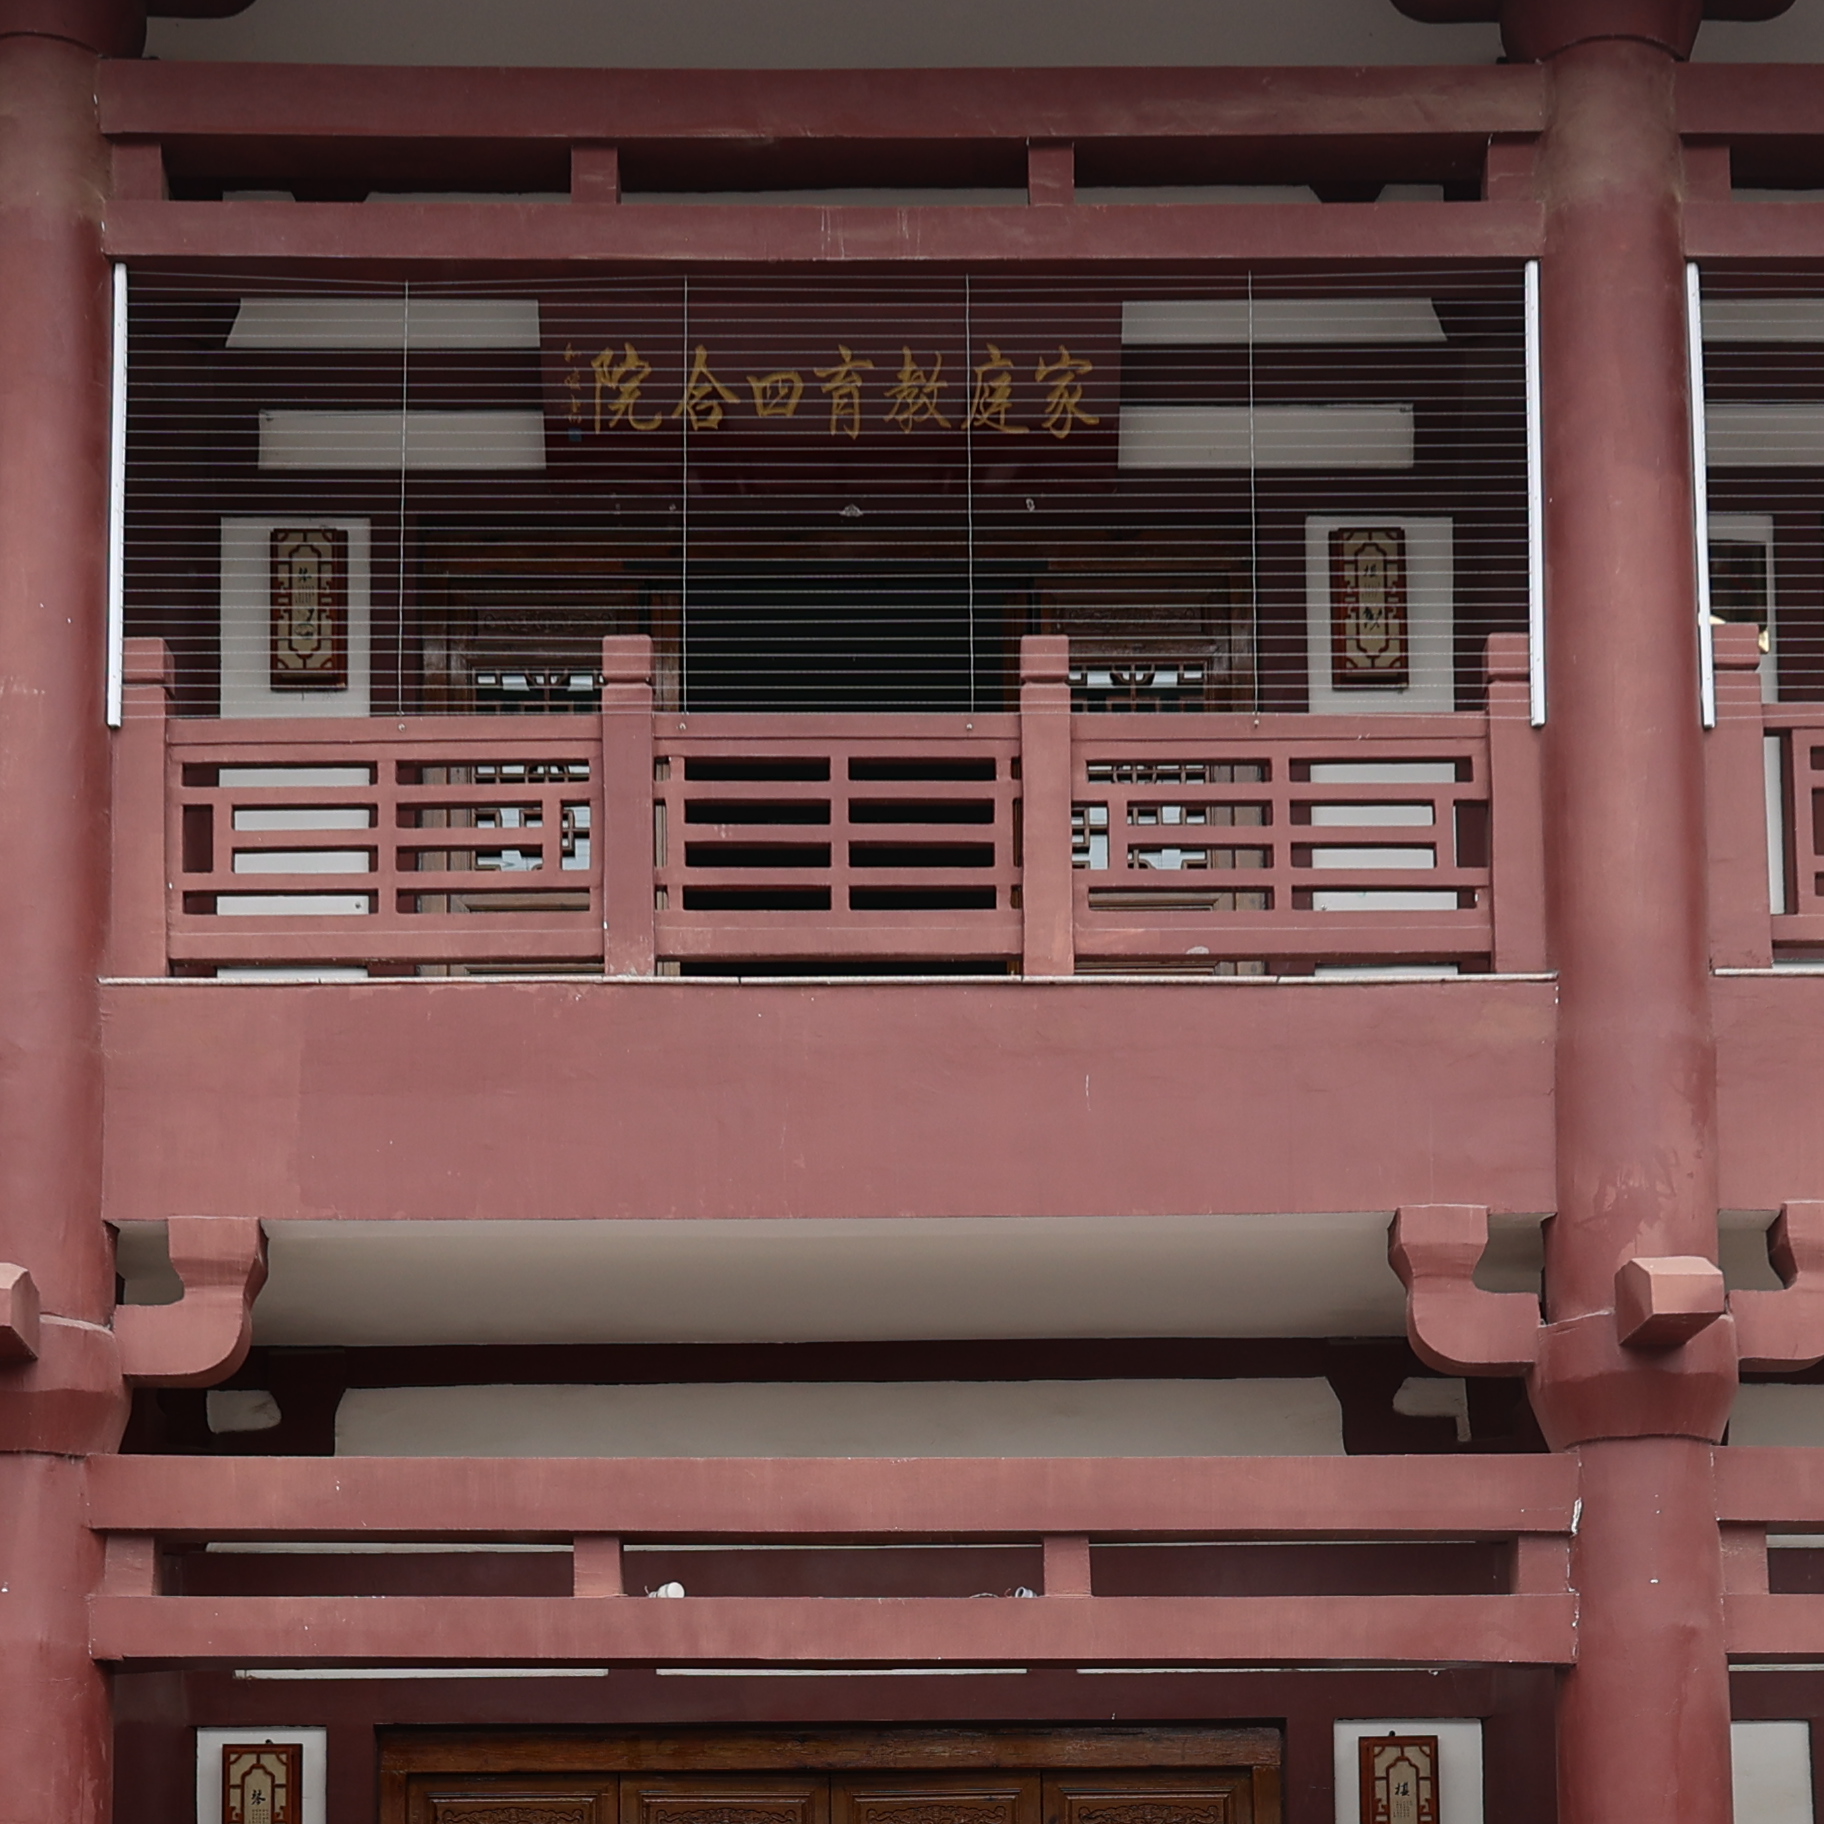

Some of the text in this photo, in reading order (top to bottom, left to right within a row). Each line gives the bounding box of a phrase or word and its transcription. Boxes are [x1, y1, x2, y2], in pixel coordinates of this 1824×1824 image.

[589, 342, 1100, 440] 家庭教育四合院
[251, 1790, 266, 1805] 琴
